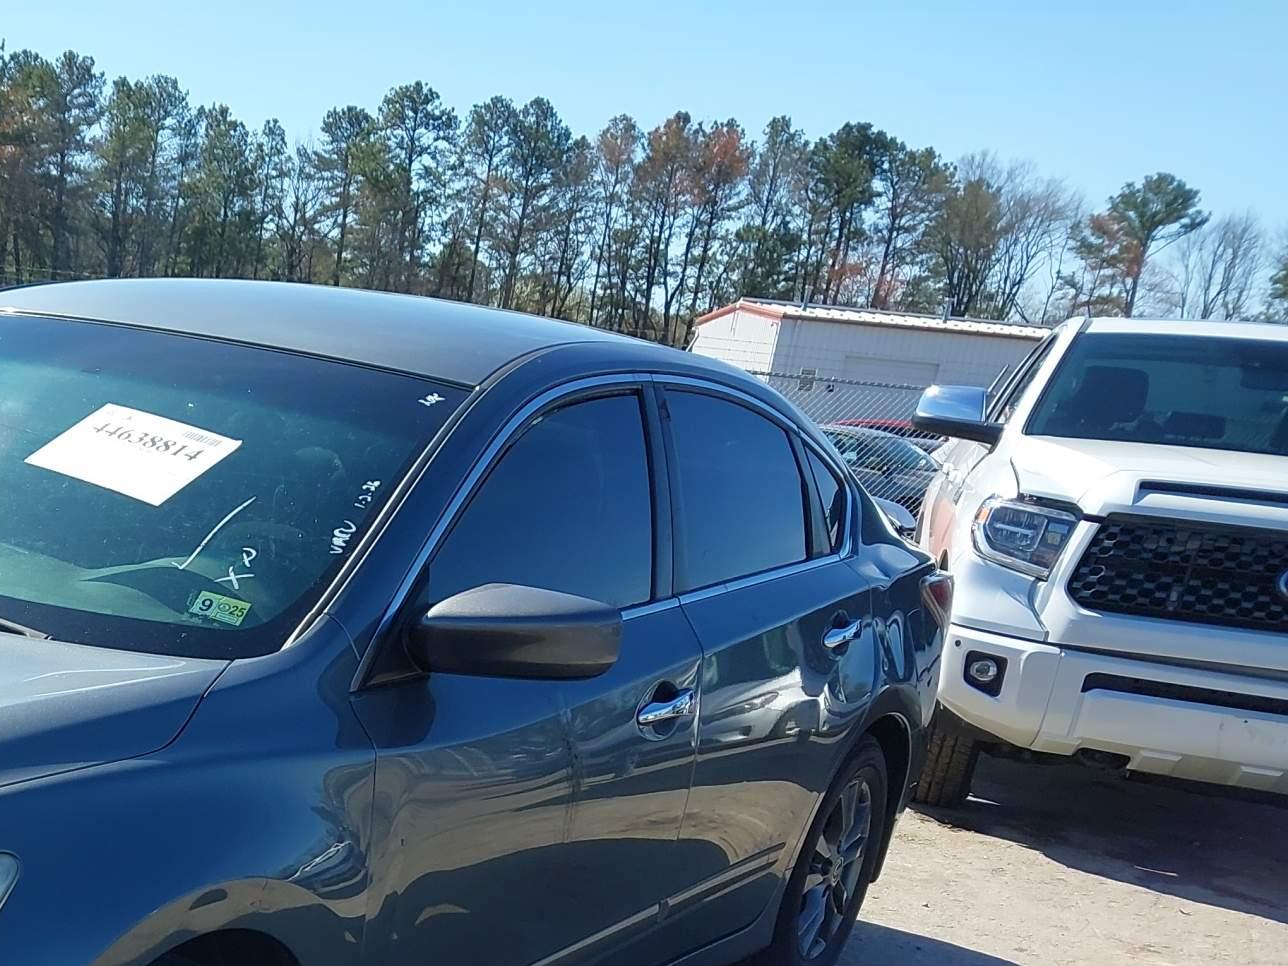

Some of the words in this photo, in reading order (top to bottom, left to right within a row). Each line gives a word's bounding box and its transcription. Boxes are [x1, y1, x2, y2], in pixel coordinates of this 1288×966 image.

[92, 422, 206, 462] 44638814
[199, 598, 214, 612] 9
[229, 605, 247, 618] 25
